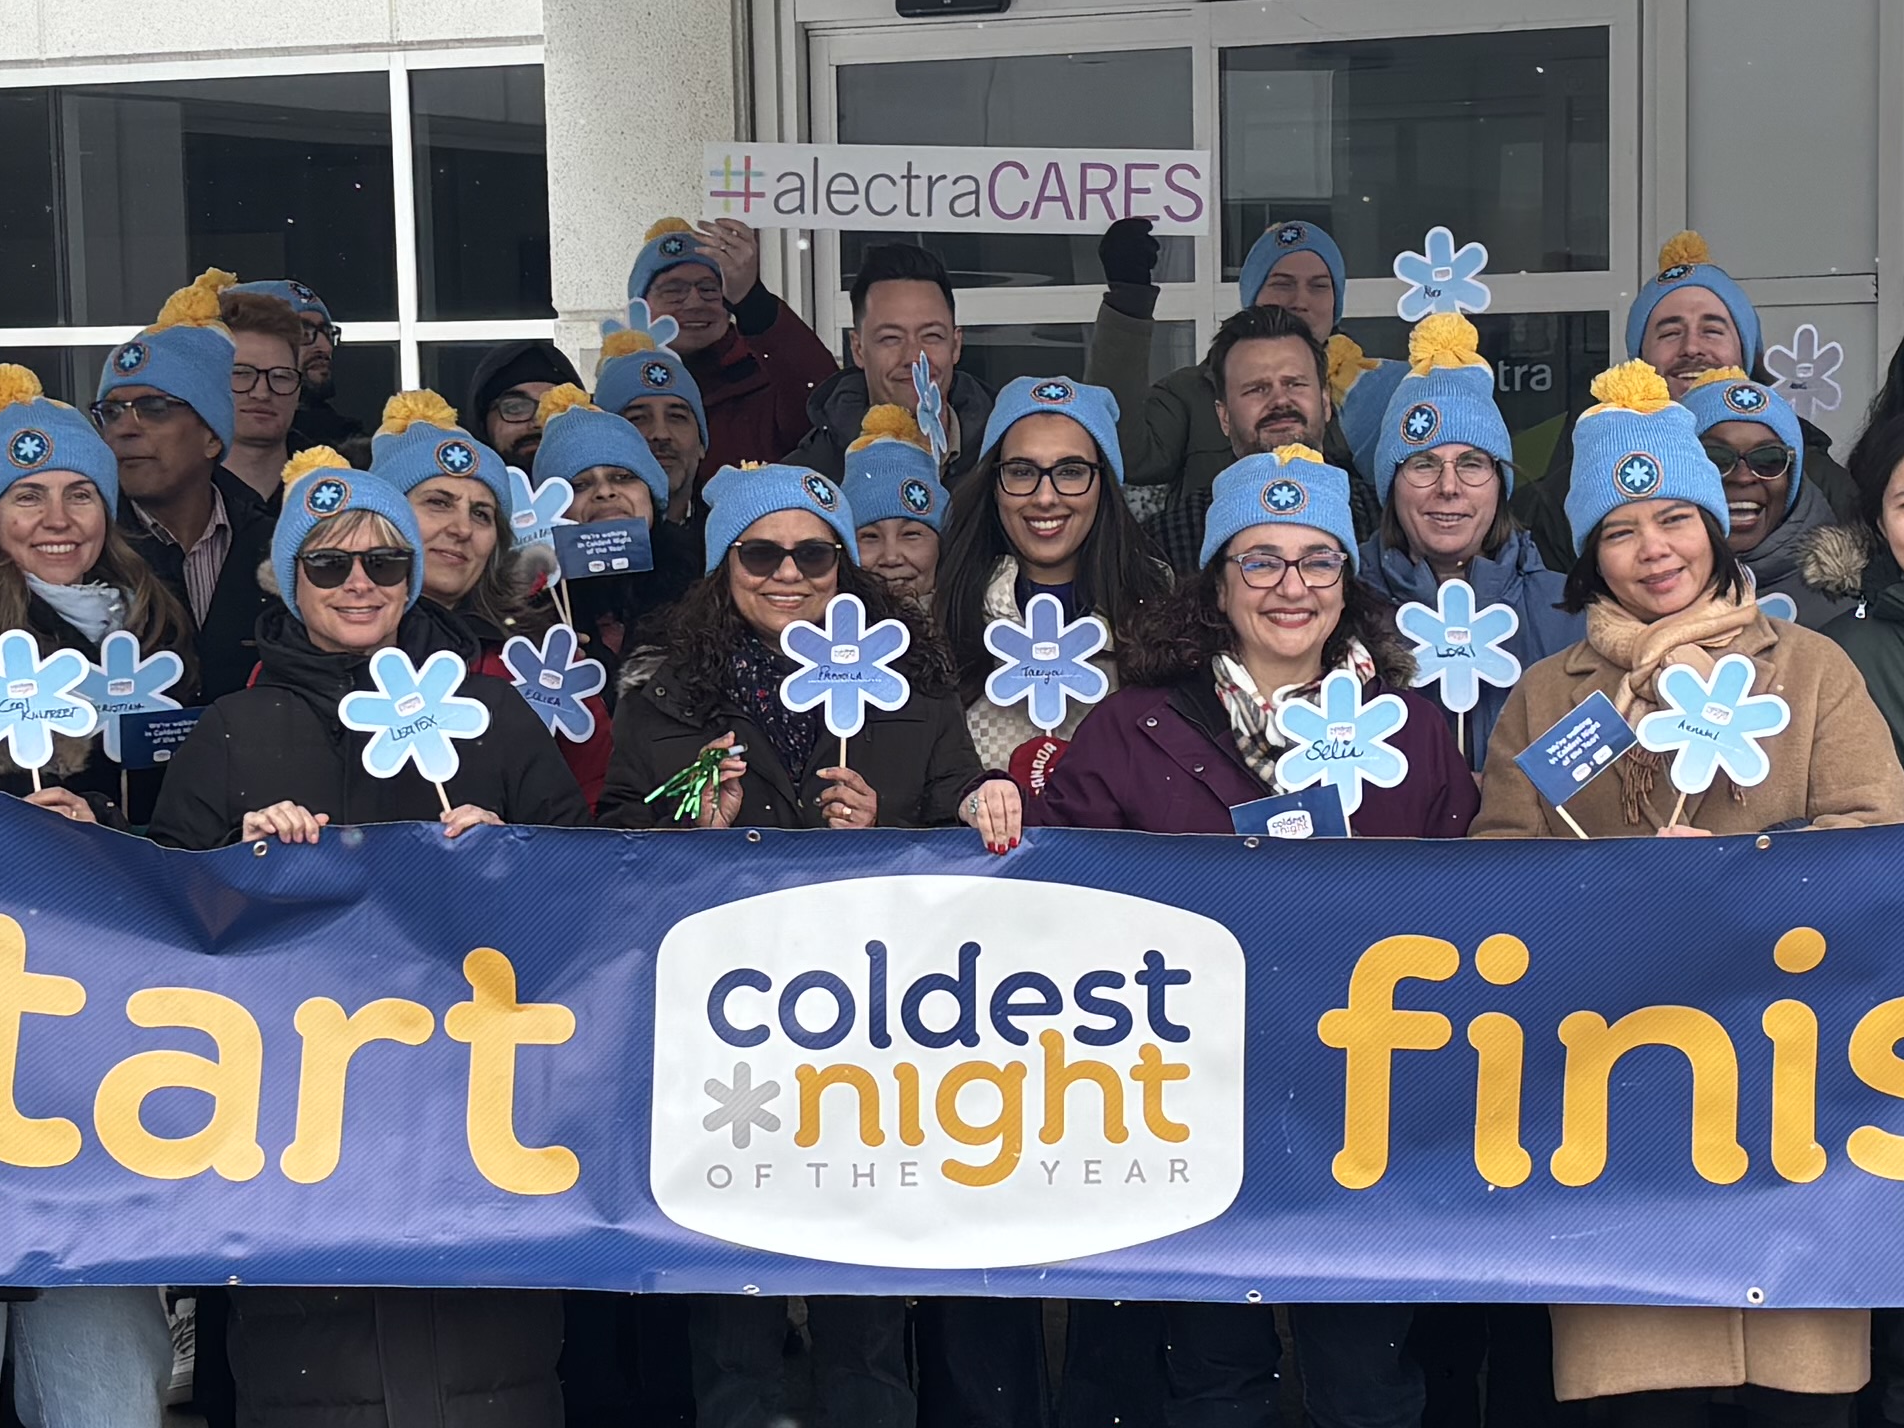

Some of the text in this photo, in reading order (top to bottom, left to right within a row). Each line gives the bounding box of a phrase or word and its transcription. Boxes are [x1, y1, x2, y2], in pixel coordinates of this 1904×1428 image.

[709, 155, 1205, 223] #alectraCARES
[1497, 360, 1553, 392] tra
[1435, 643, 1476, 658] LORI
[1030, 741, 1058, 795] ANADA
[706, 939, 1192, 1050] coldest
[794, 1028, 1192, 1188] night
[706, 1157, 1192, 1190] OF THE YEAR
